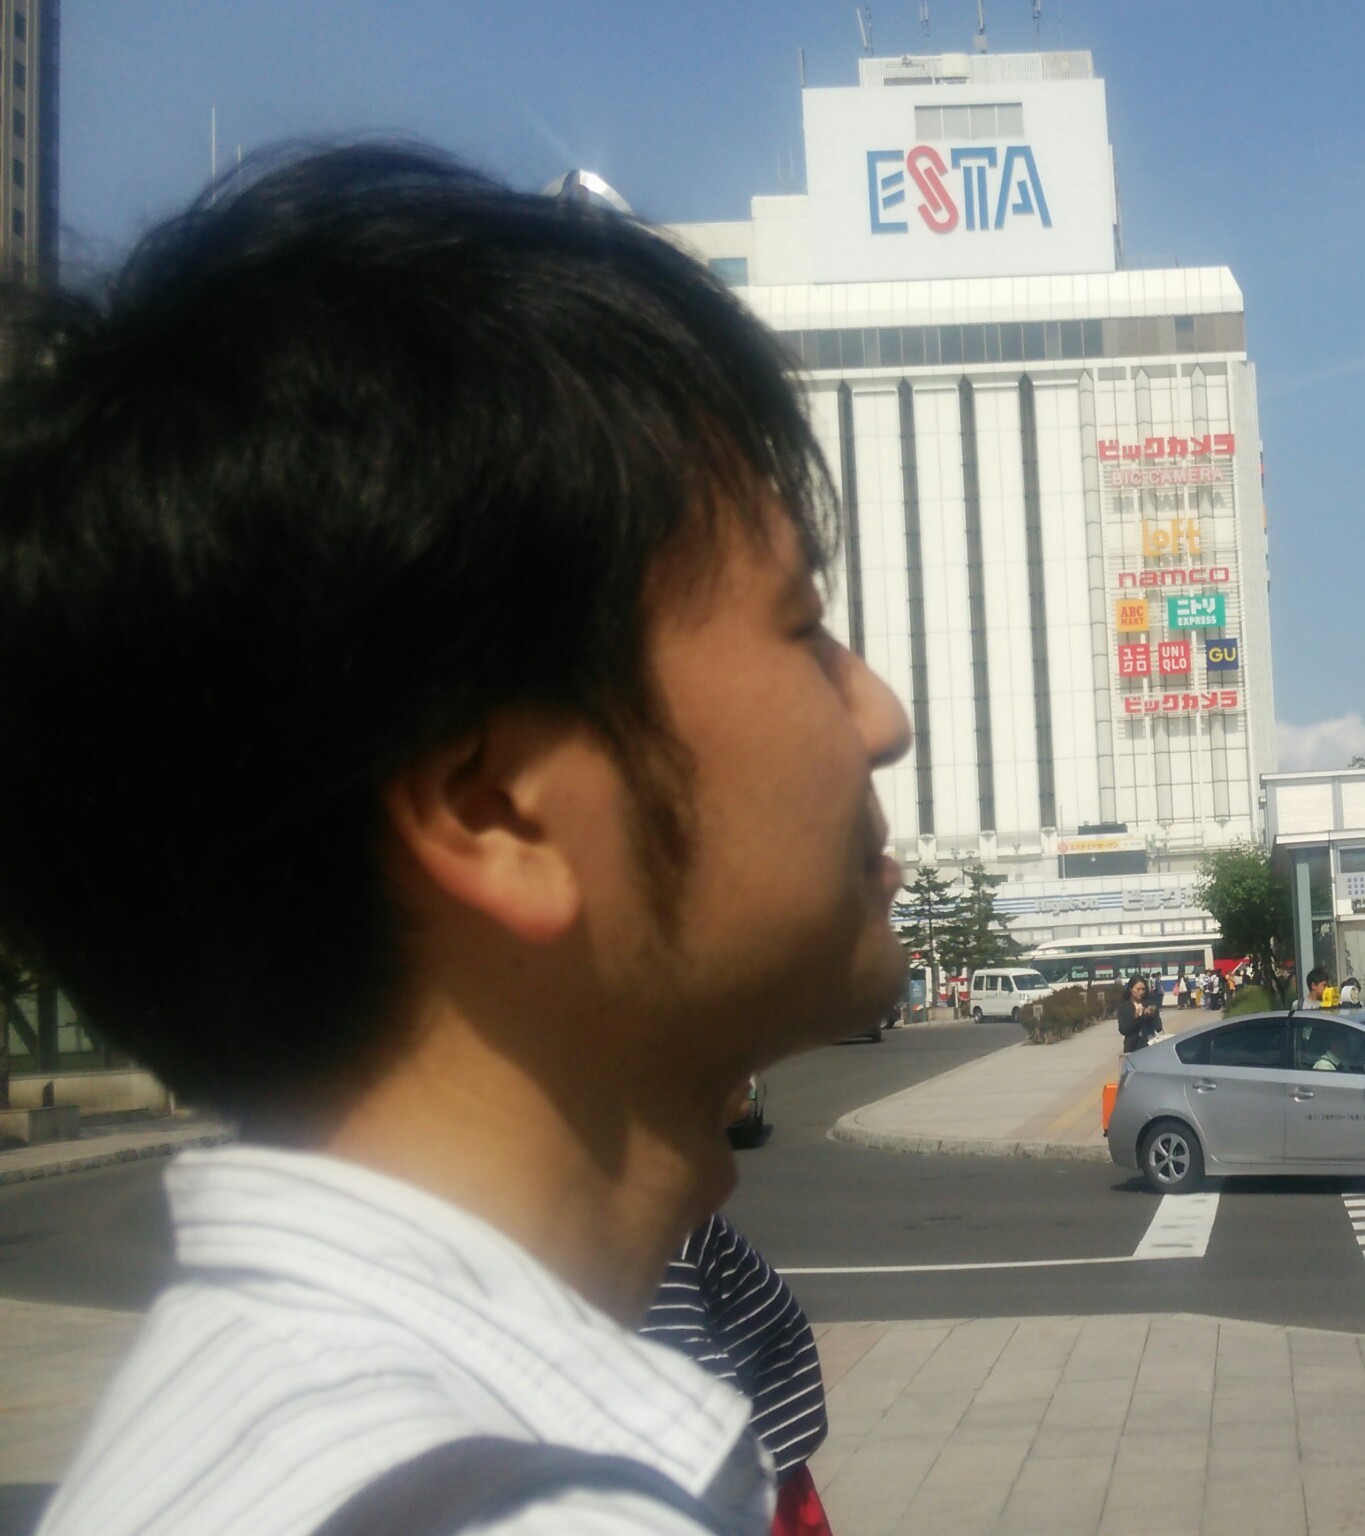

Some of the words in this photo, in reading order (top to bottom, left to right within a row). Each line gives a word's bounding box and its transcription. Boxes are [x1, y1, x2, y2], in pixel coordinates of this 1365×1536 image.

[867, 145, 1053, 235] ESTA
[1098, 434, 1236, 461] ビックカメラ
[1111, 470, 1143, 487] BIC
[1149, 466, 1226, 485] CAMERA
[1118, 567, 1230, 588] namco
[1121, 606, 1144, 618] ABC
[1177, 598, 1216, 615] ニトリ
[1121, 617, 1145, 627] MART
[1178, 615, 1217, 627] EXPRESS
[1162, 646, 1185, 658] UNI
[1208, 647, 1236, 662] GU
[1162, 658, 1187, 671] QLO
[1124, 690, 1238, 714] ビックカメラ
